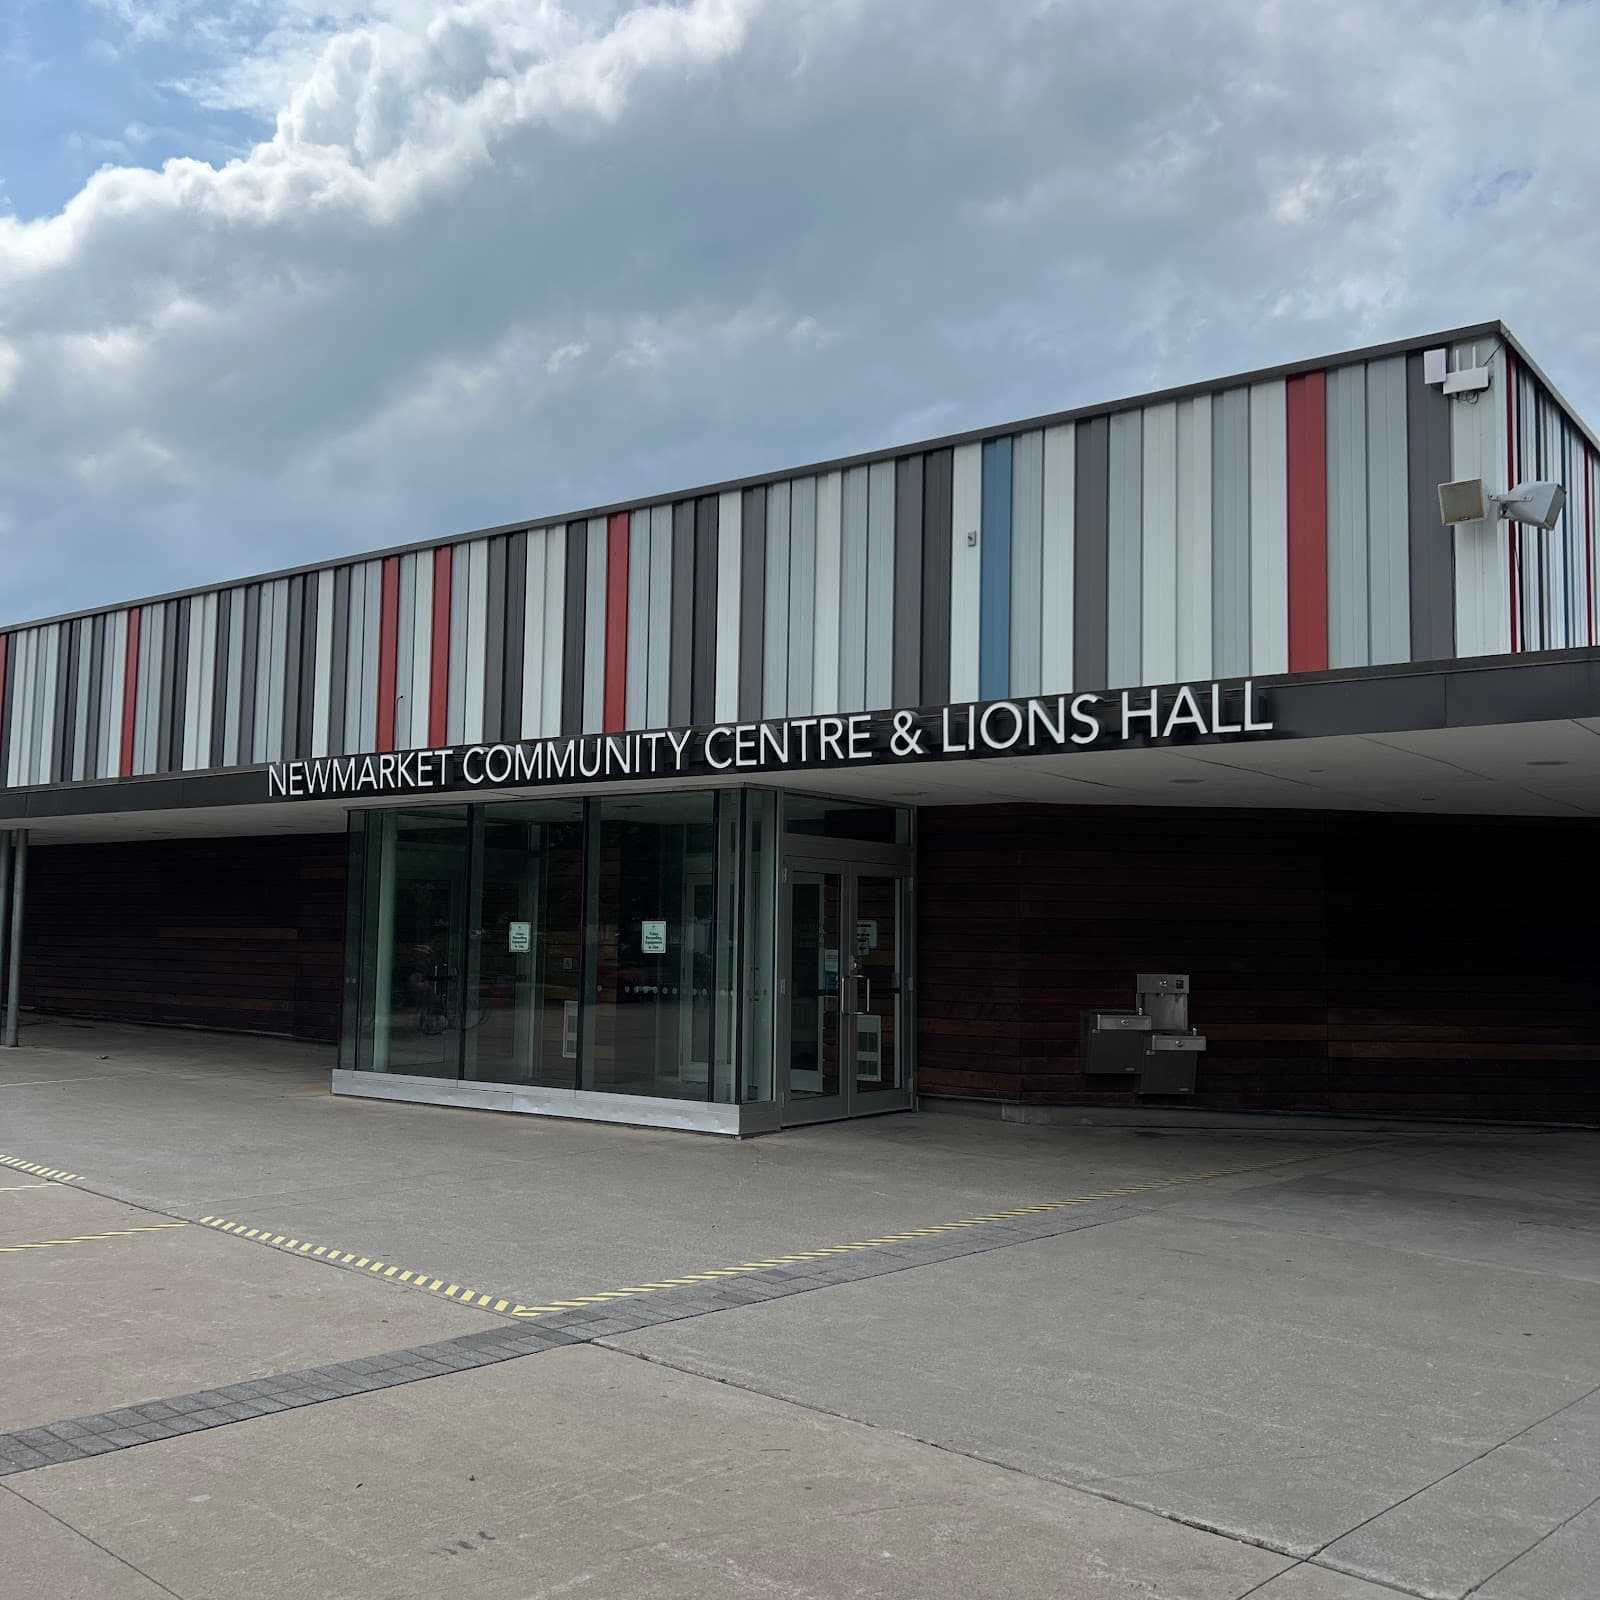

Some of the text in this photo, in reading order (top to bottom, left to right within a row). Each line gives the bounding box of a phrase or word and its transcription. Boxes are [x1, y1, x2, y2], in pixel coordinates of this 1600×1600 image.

[267, 680, 1274, 797] NEWMARKET COMMUNITY CENTRE & LIONS HALL
